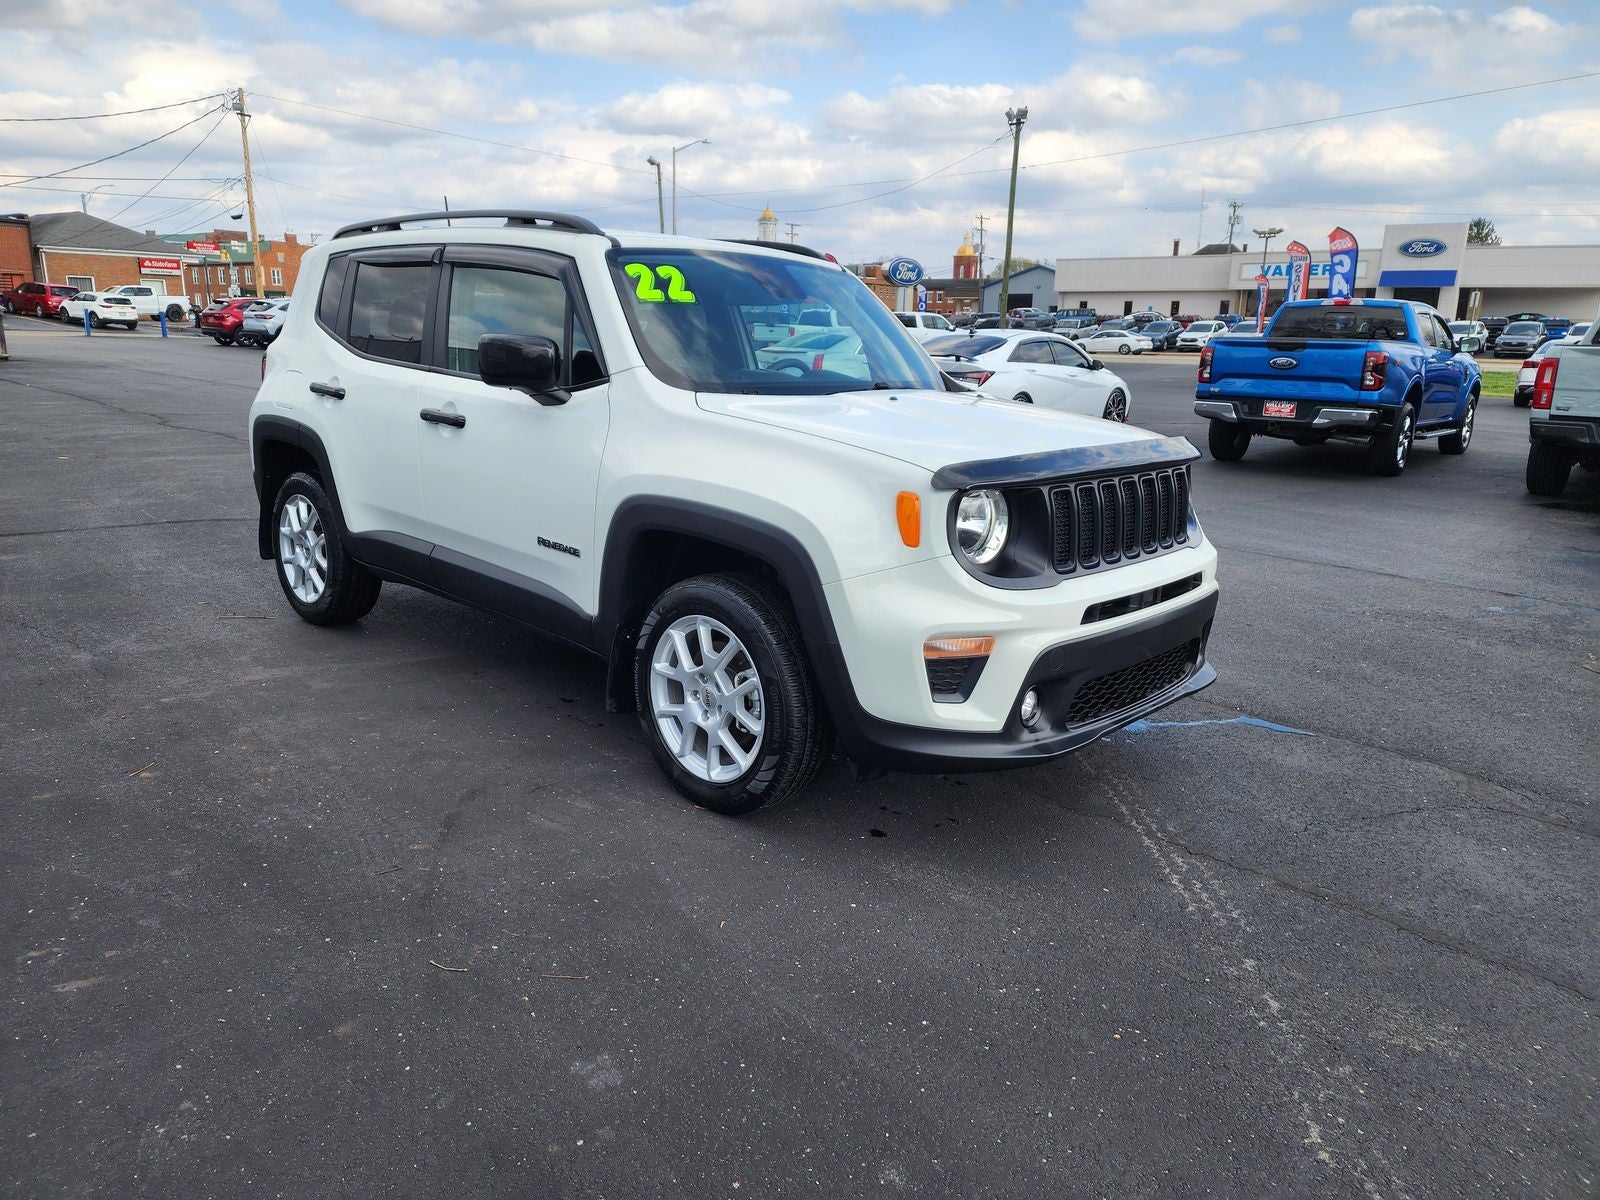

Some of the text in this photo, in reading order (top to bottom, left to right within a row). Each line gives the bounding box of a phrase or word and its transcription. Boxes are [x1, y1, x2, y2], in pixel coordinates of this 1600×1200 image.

[1408, 241, 1437, 253] Ford
[896, 262, 918, 281] Ford
[624, 263, 696, 303] 22
[537, 536, 581, 558] RENEGADE
